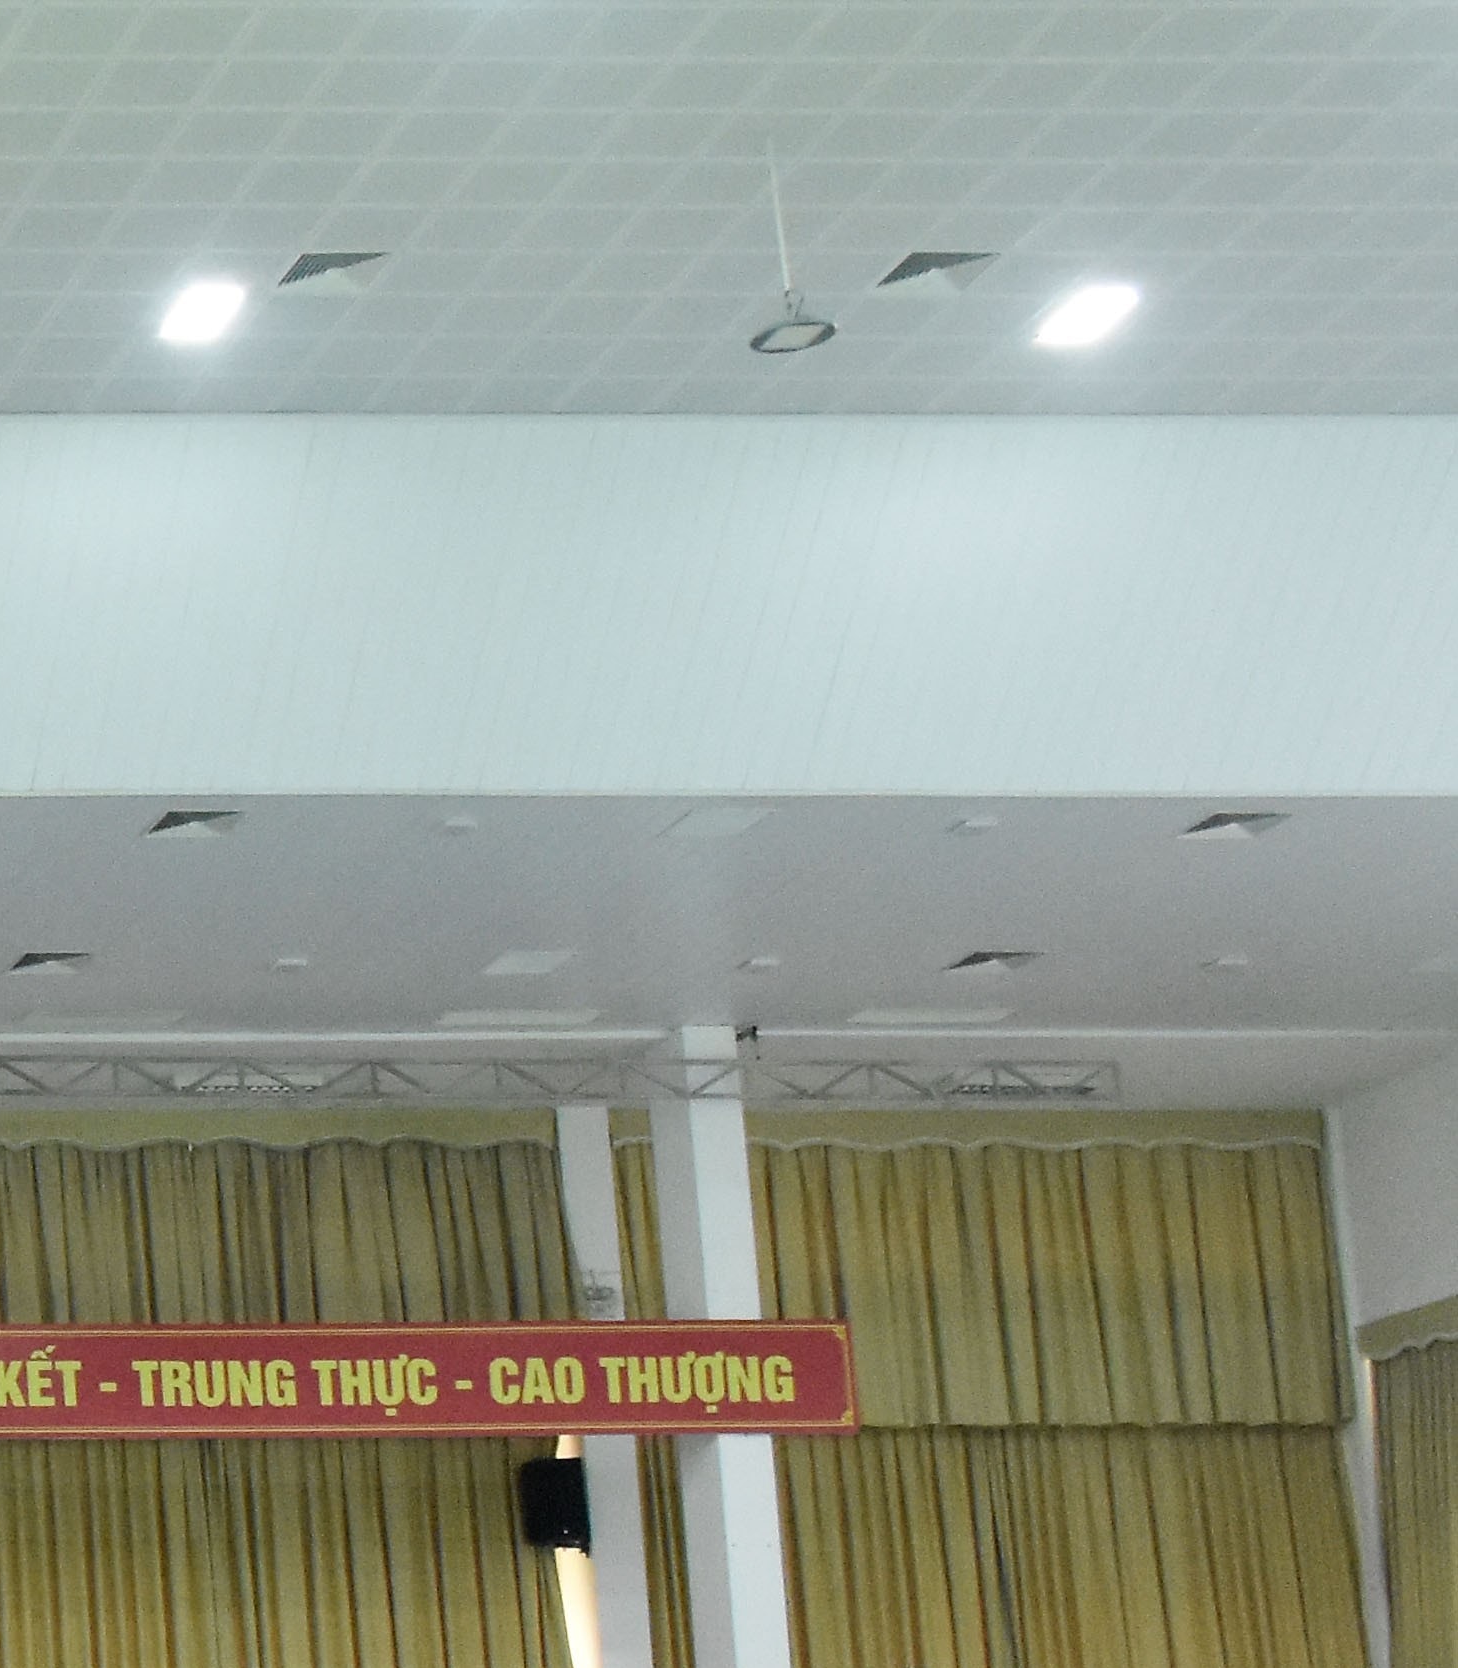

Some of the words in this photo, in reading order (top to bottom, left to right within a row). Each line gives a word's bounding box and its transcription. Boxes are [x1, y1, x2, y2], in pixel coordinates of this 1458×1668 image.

[100, 1382, 117, 1392] -
[132, 1360, 297, 1407] TRUNG
[311, 1354, 437, 1416] THỰC
[455, 1380, 473, 1389] -
[489, 1357, 585, 1404] CAO
[599, 1351, 795, 1413] THƯỢNG
